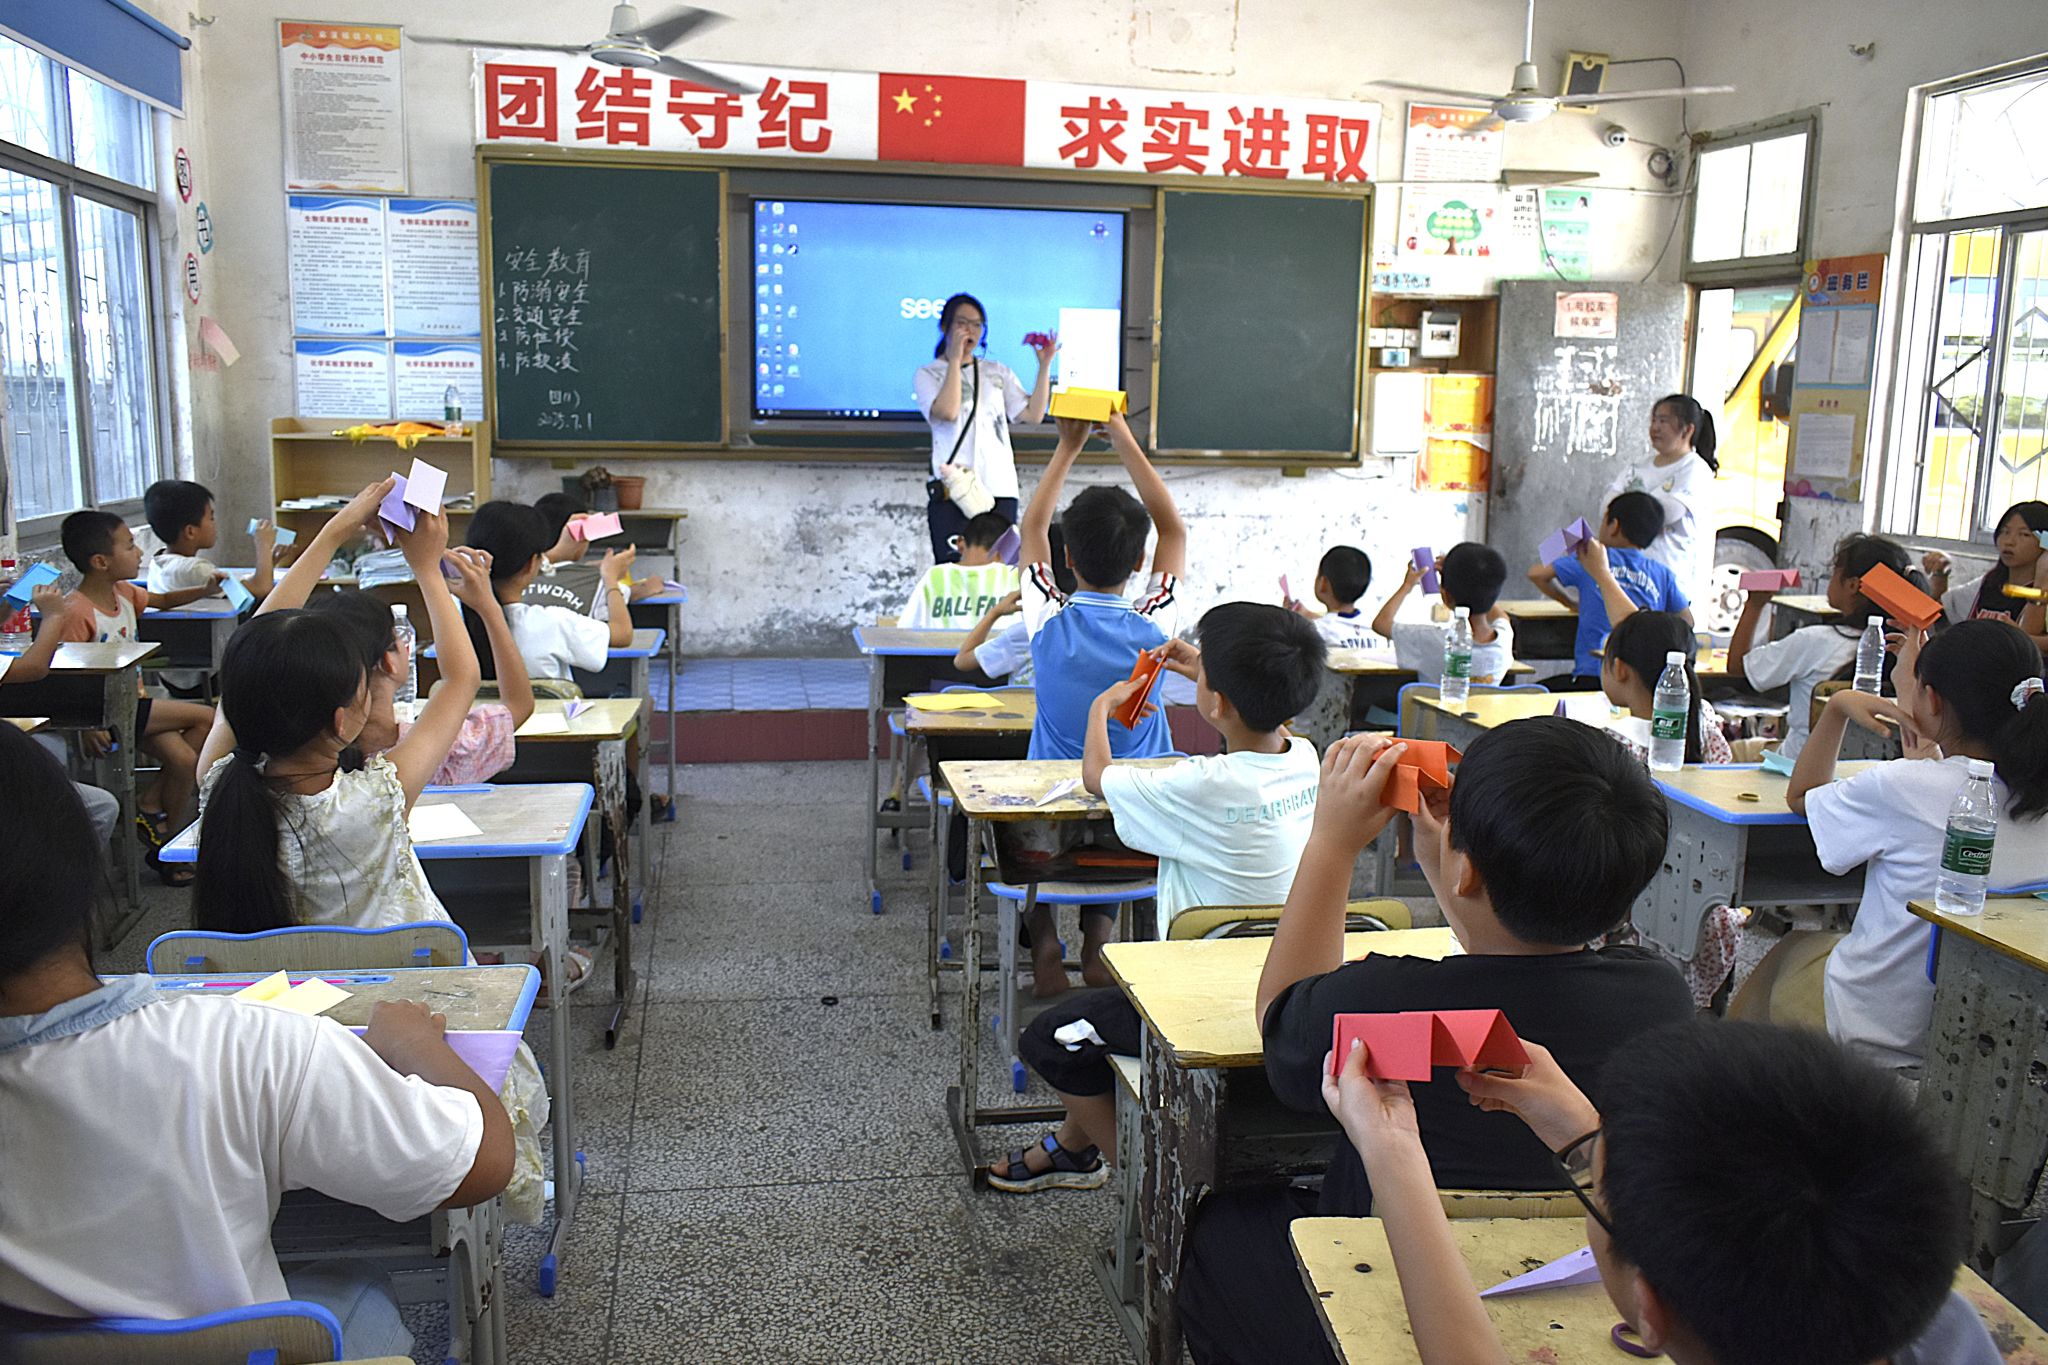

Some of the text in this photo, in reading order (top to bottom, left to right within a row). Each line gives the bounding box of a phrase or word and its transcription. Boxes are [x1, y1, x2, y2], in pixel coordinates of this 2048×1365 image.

[485, 63, 832, 154] 团结守纪
[1058, 96, 1370, 182] 求实进取
[505, 246, 591, 280] 安全教育
[521, 584, 584, 610] TWORK
[932, 596, 972, 618] BALL
